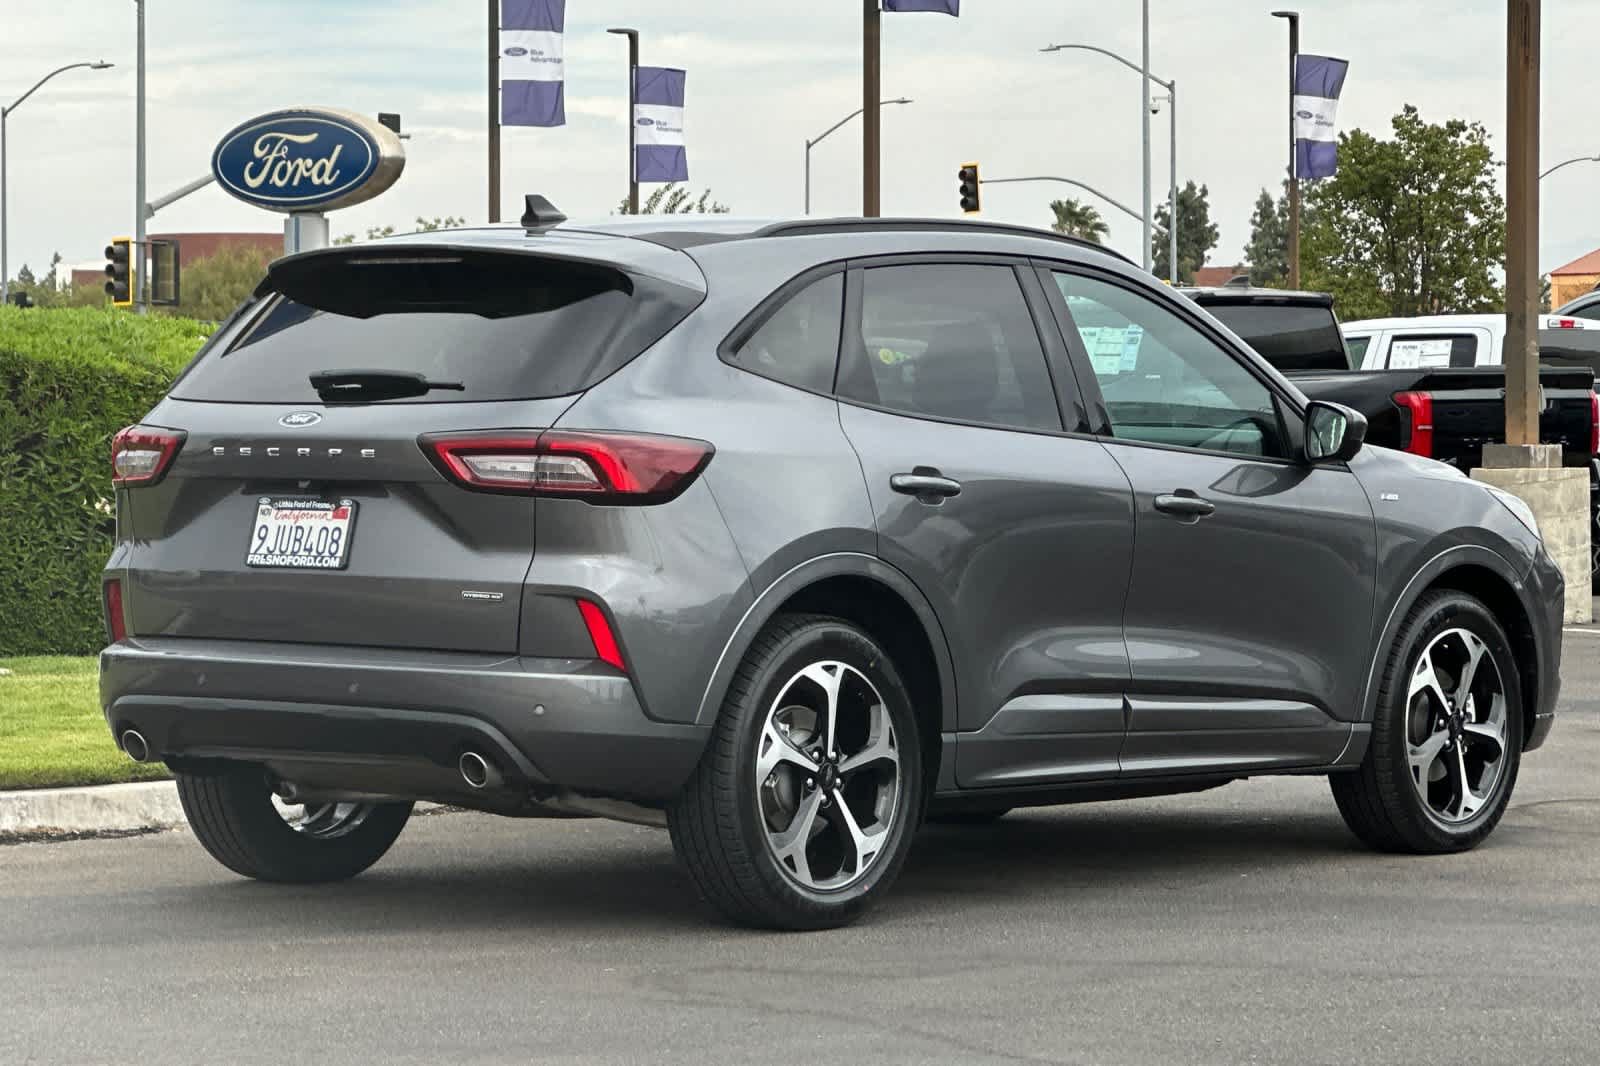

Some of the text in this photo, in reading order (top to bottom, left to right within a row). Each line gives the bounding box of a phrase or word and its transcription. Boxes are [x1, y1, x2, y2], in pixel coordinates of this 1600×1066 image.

[243, 132, 343, 188] Ford
[213, 446, 375, 458] ESCAPE
[294, 500, 306, 508] Ford
[274, 510, 329, 523] California
[254, 524, 342, 557] 9JUB408
[247, 554, 340, 567] FRESNOFORD.COM
